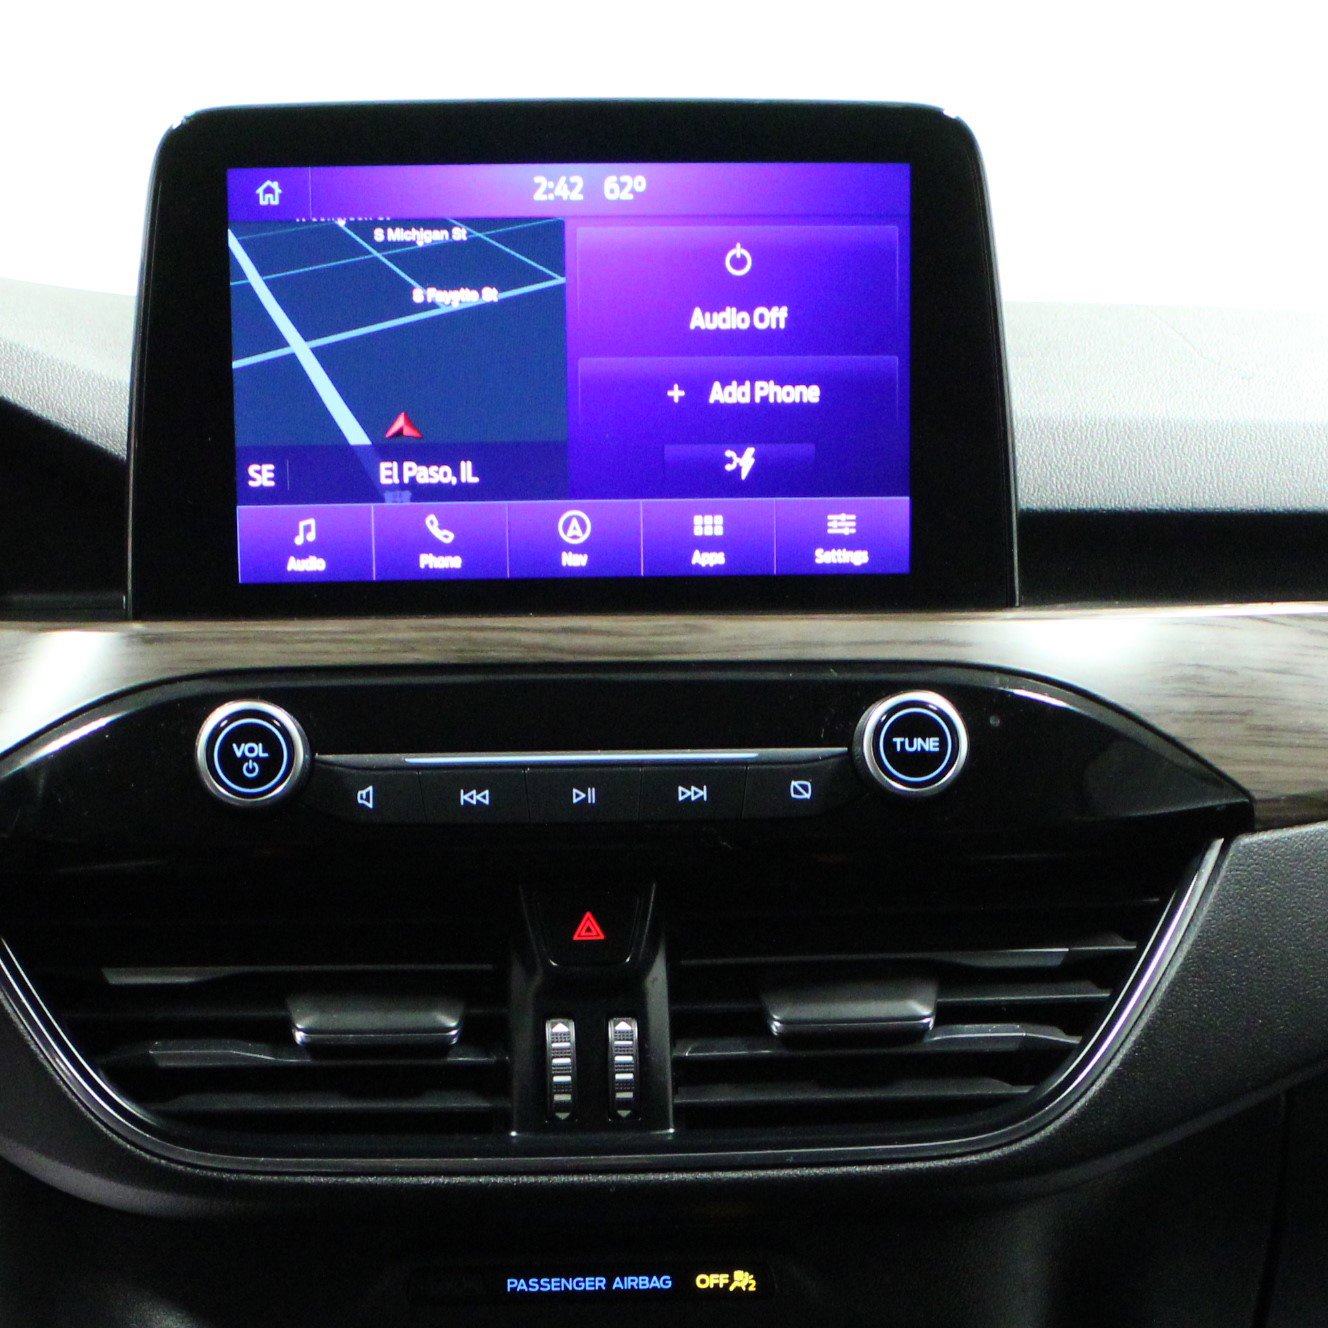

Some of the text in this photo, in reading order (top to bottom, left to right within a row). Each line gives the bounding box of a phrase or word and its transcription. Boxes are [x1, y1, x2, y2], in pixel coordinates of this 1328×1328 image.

[533, 175, 583, 200] 2:42
[373, 226, 468, 246] S Michigan St
[689, 306, 788, 330] Audio Off
[709, 379, 820, 403] Add Phone
[247, 463, 275, 487] SE
[379, 460, 480, 486] El Paso, IL
[287, 555, 327, 572] Audio
[419, 553, 462, 569] Phone
[561, 551, 588, 567] Nav
[692, 550, 725, 567] Apps
[814, 548, 870, 567] Settings
[232, 742, 269, 758] VOL
[892, 737, 940, 752] TUNE
[507, 1273, 730, 1292] PASSENGER AIRBAG OFF
